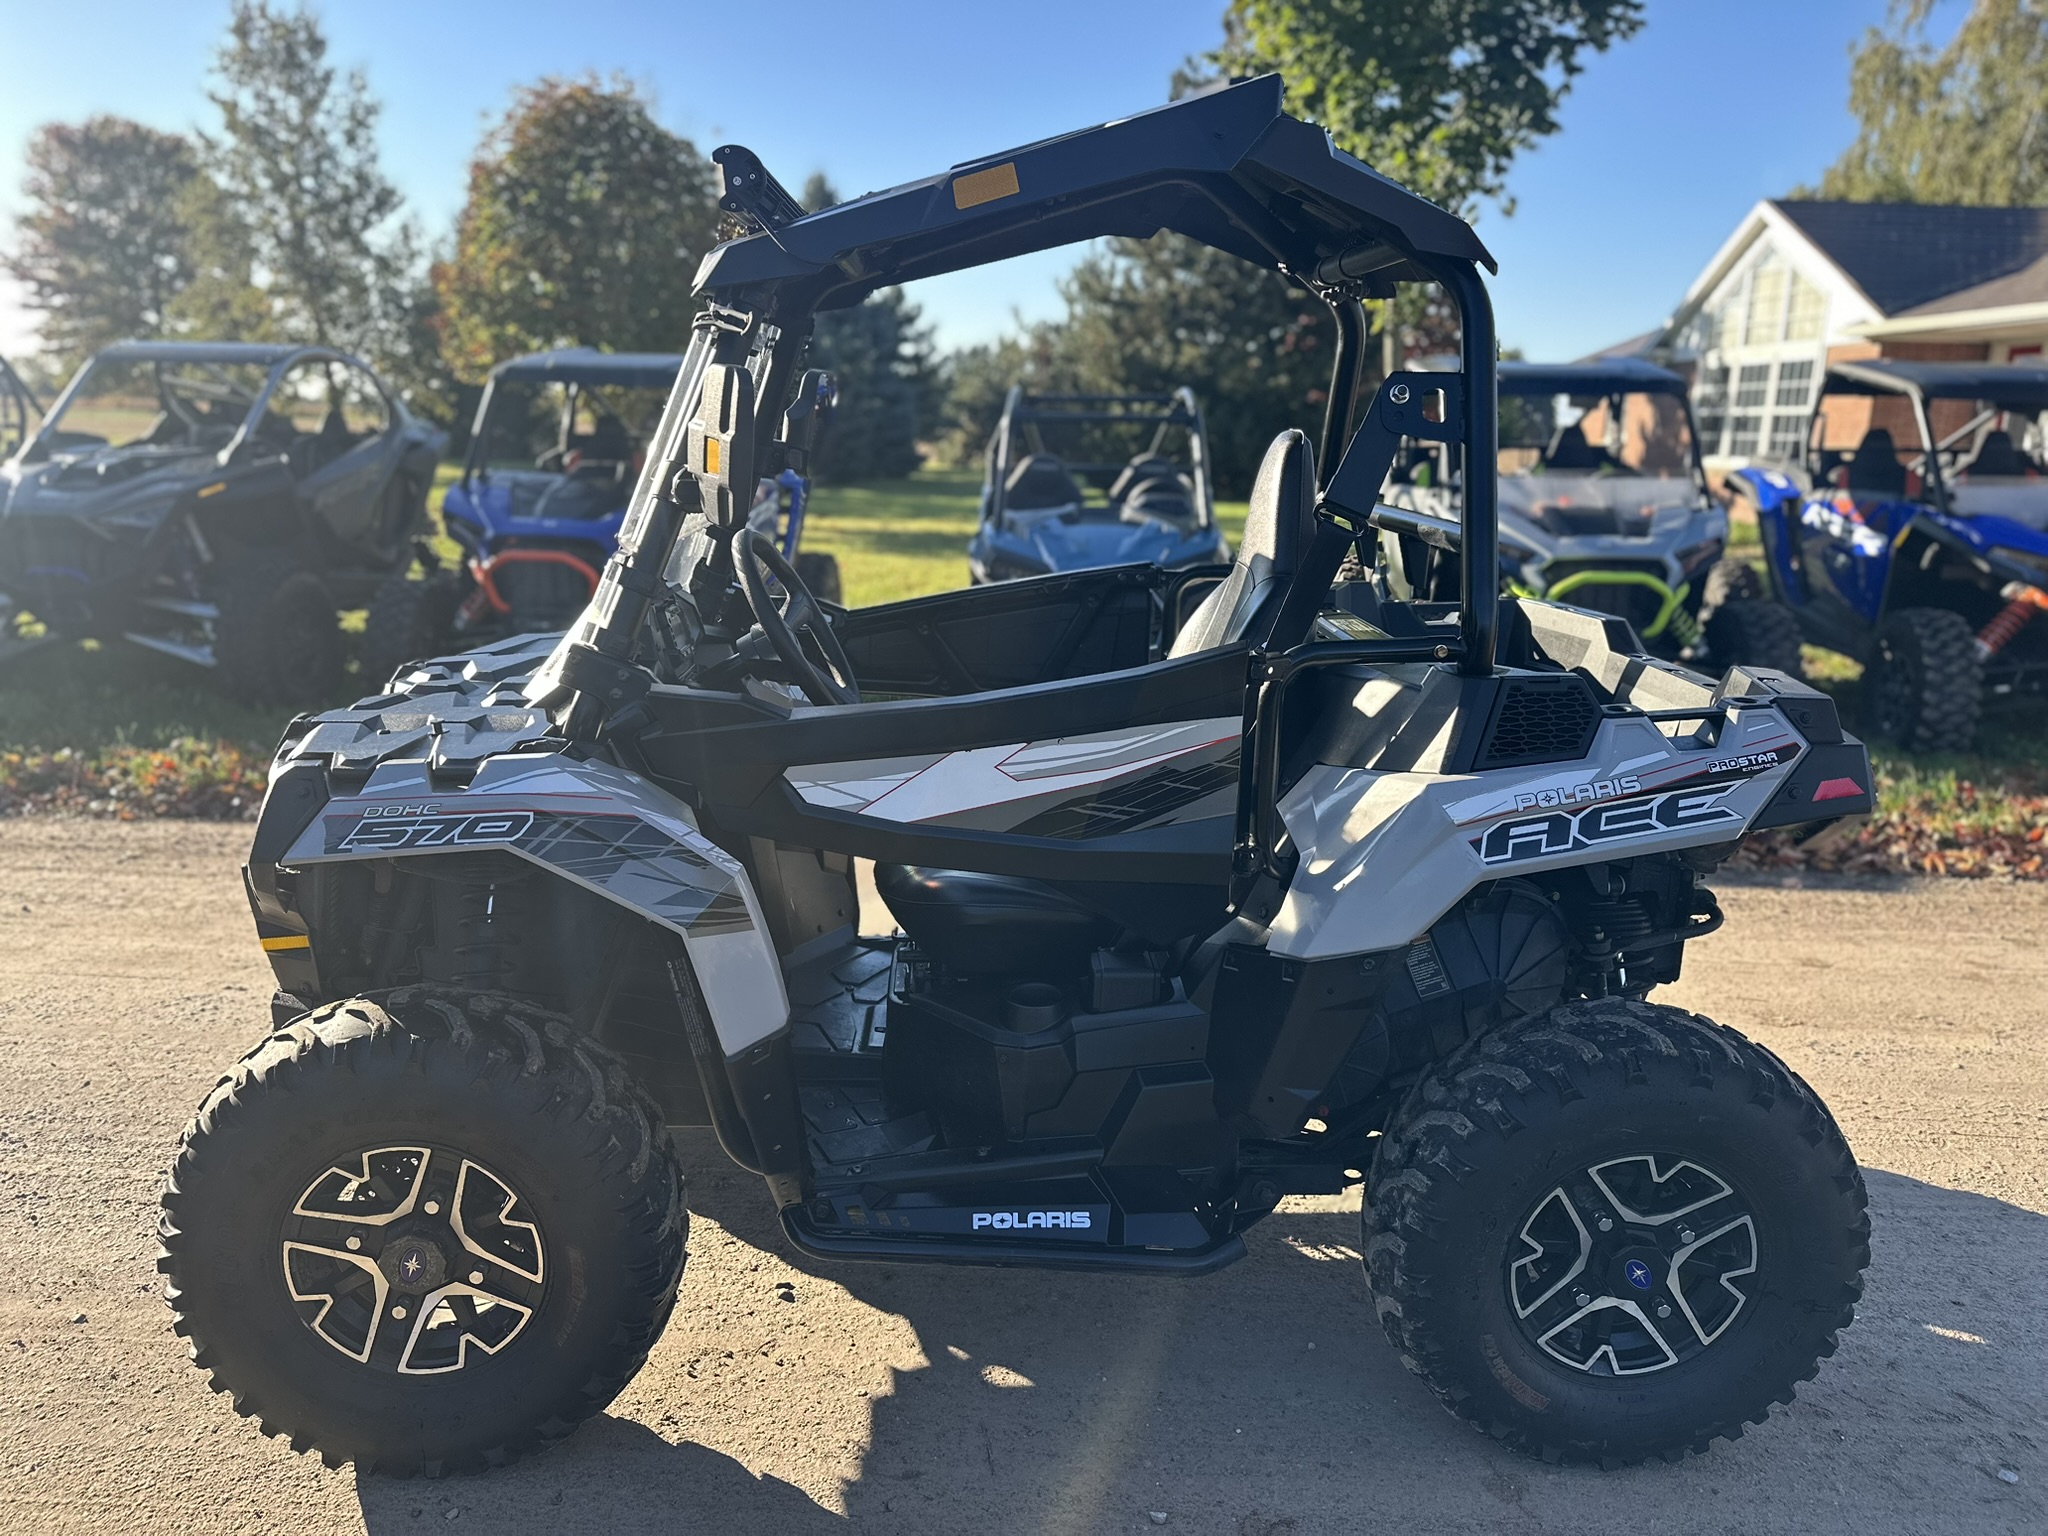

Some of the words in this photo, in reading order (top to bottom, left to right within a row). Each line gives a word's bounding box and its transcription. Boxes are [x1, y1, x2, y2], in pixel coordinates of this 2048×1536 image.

[1707, 752, 1778, 773] PROSTAR
[1515, 775, 1642, 812] POLARIS
[363, 804, 441, 818] DOHC
[1480, 778, 1750, 862] ACE
[338, 812, 534, 849] 570
[972, 1212, 1091, 1230] POLARIS
